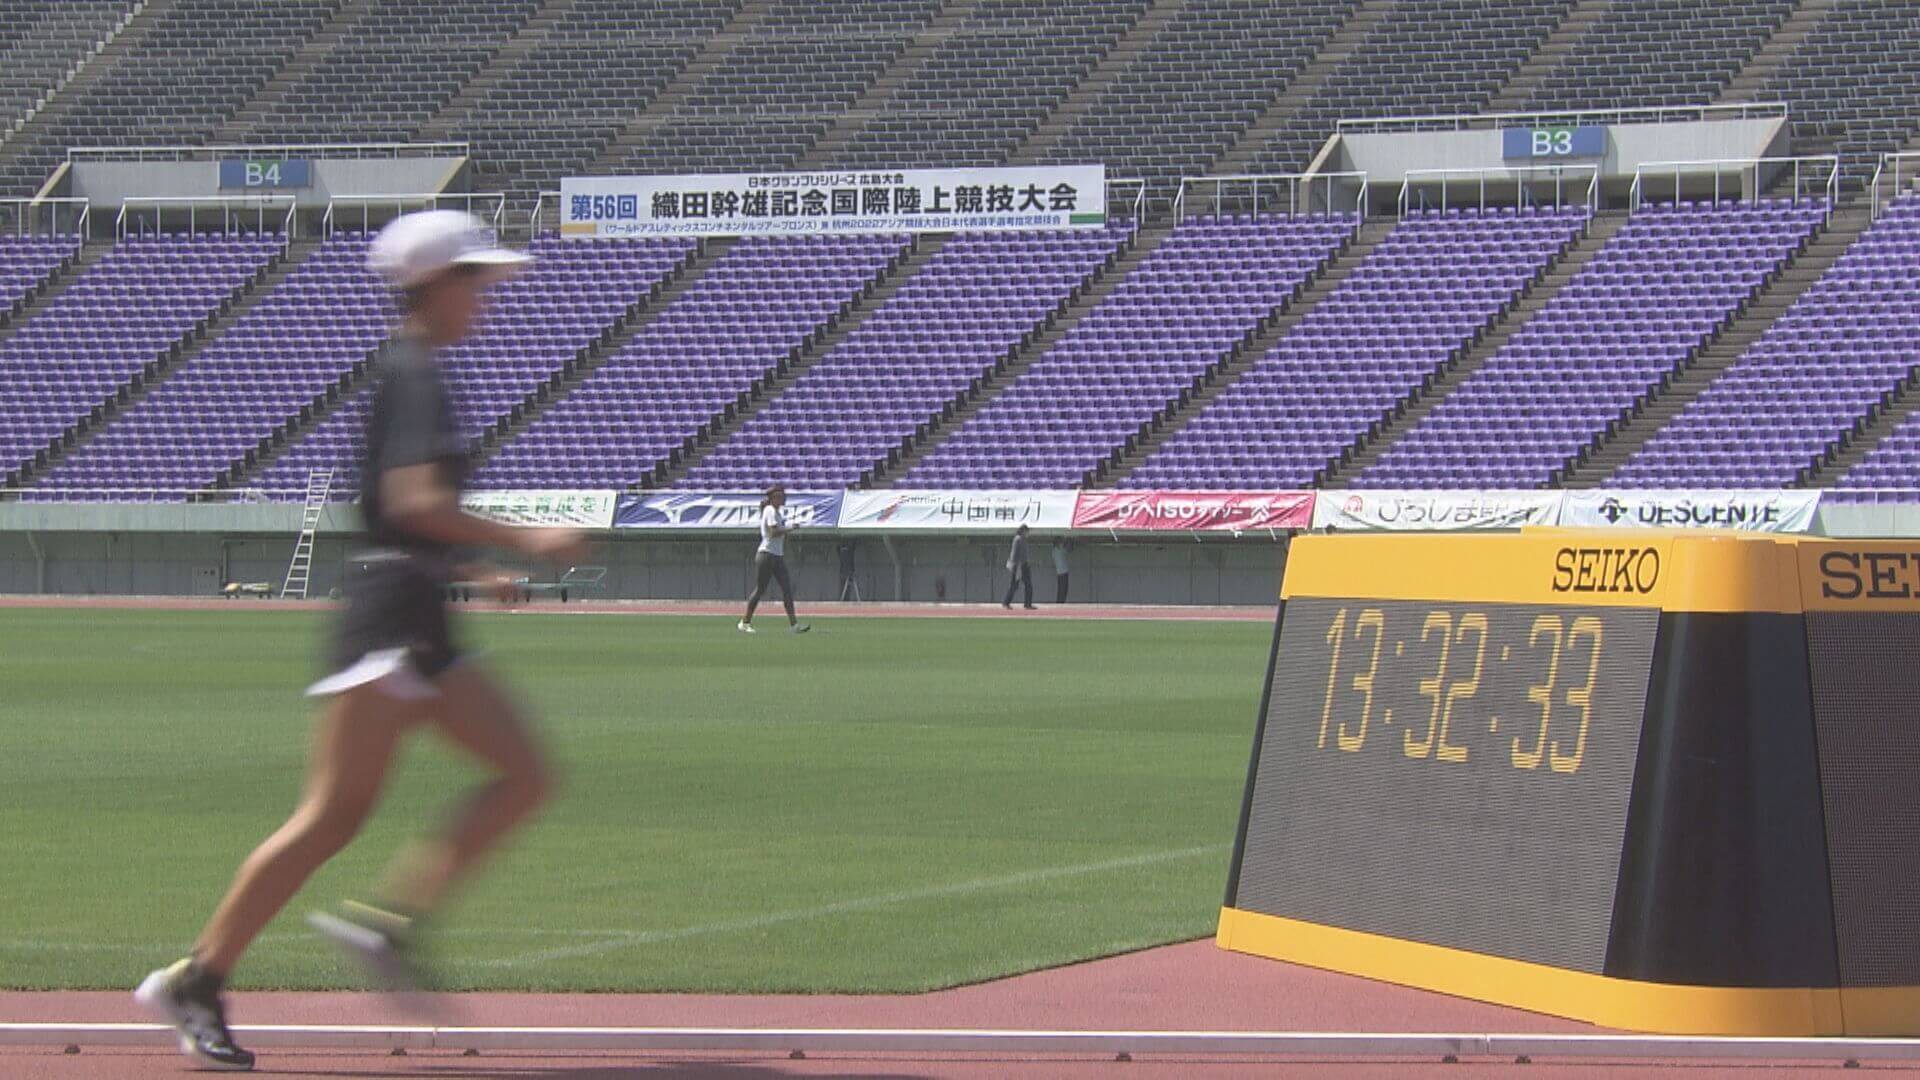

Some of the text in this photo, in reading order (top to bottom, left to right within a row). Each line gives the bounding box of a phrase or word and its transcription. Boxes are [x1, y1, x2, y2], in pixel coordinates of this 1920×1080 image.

[1532, 131, 1573, 156] B3
[245, 163, 282, 186] B4
[860, 172, 905, 186] 広島大会
[570, 182, 1079, 221] 第56回 織田幹雄記念国際陸上競技大会
[941, 496, 1042, 523] 中国電力
[1638, 499, 1779, 525] DESCENTE
[1552, 547, 1660, 594] SEIKO
[1317, 608, 1603, 774] 13:32:33
